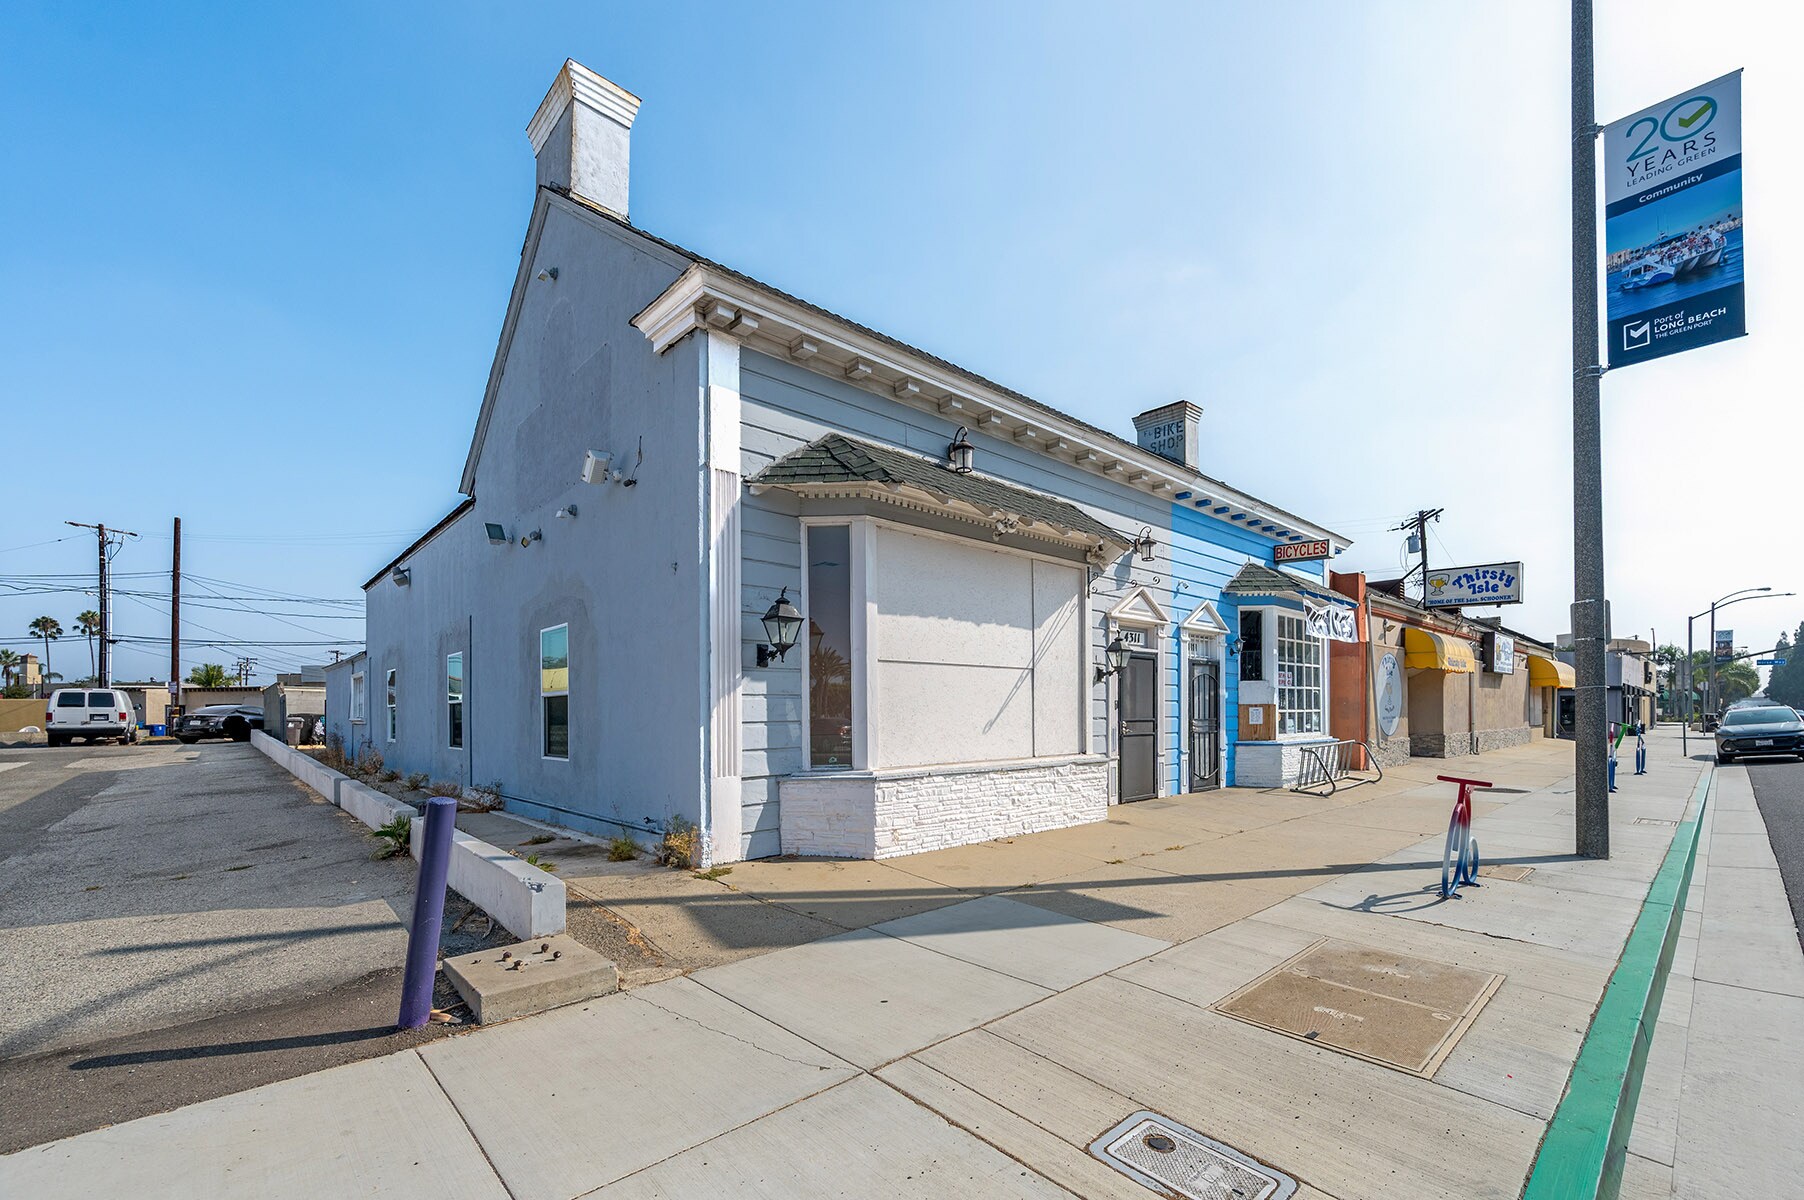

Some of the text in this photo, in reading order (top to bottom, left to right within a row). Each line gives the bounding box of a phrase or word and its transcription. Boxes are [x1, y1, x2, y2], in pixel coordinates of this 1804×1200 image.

[1625, 95, 1718, 163] 20
[1626, 131, 1717, 178] YEARS
[1626, 146, 1717, 188] LEADING GREEN
[1638, 173, 1704, 203] Community
[1654, 310, 1685, 326] Port of
[1654, 307, 1727, 333] LONG BEACH
[1655, 319, 1713, 339] THE GREEN PORT
[1154, 420, 1184, 439] BIKE
[1150, 434, 1183, 453] SHOP
[1275, 541, 1327, 559] BICYCLES
[1452, 568, 1516, 589] Thirsty
[1467, 580, 1499, 595] Isle
[1123, 632, 1140, 644] 4311
